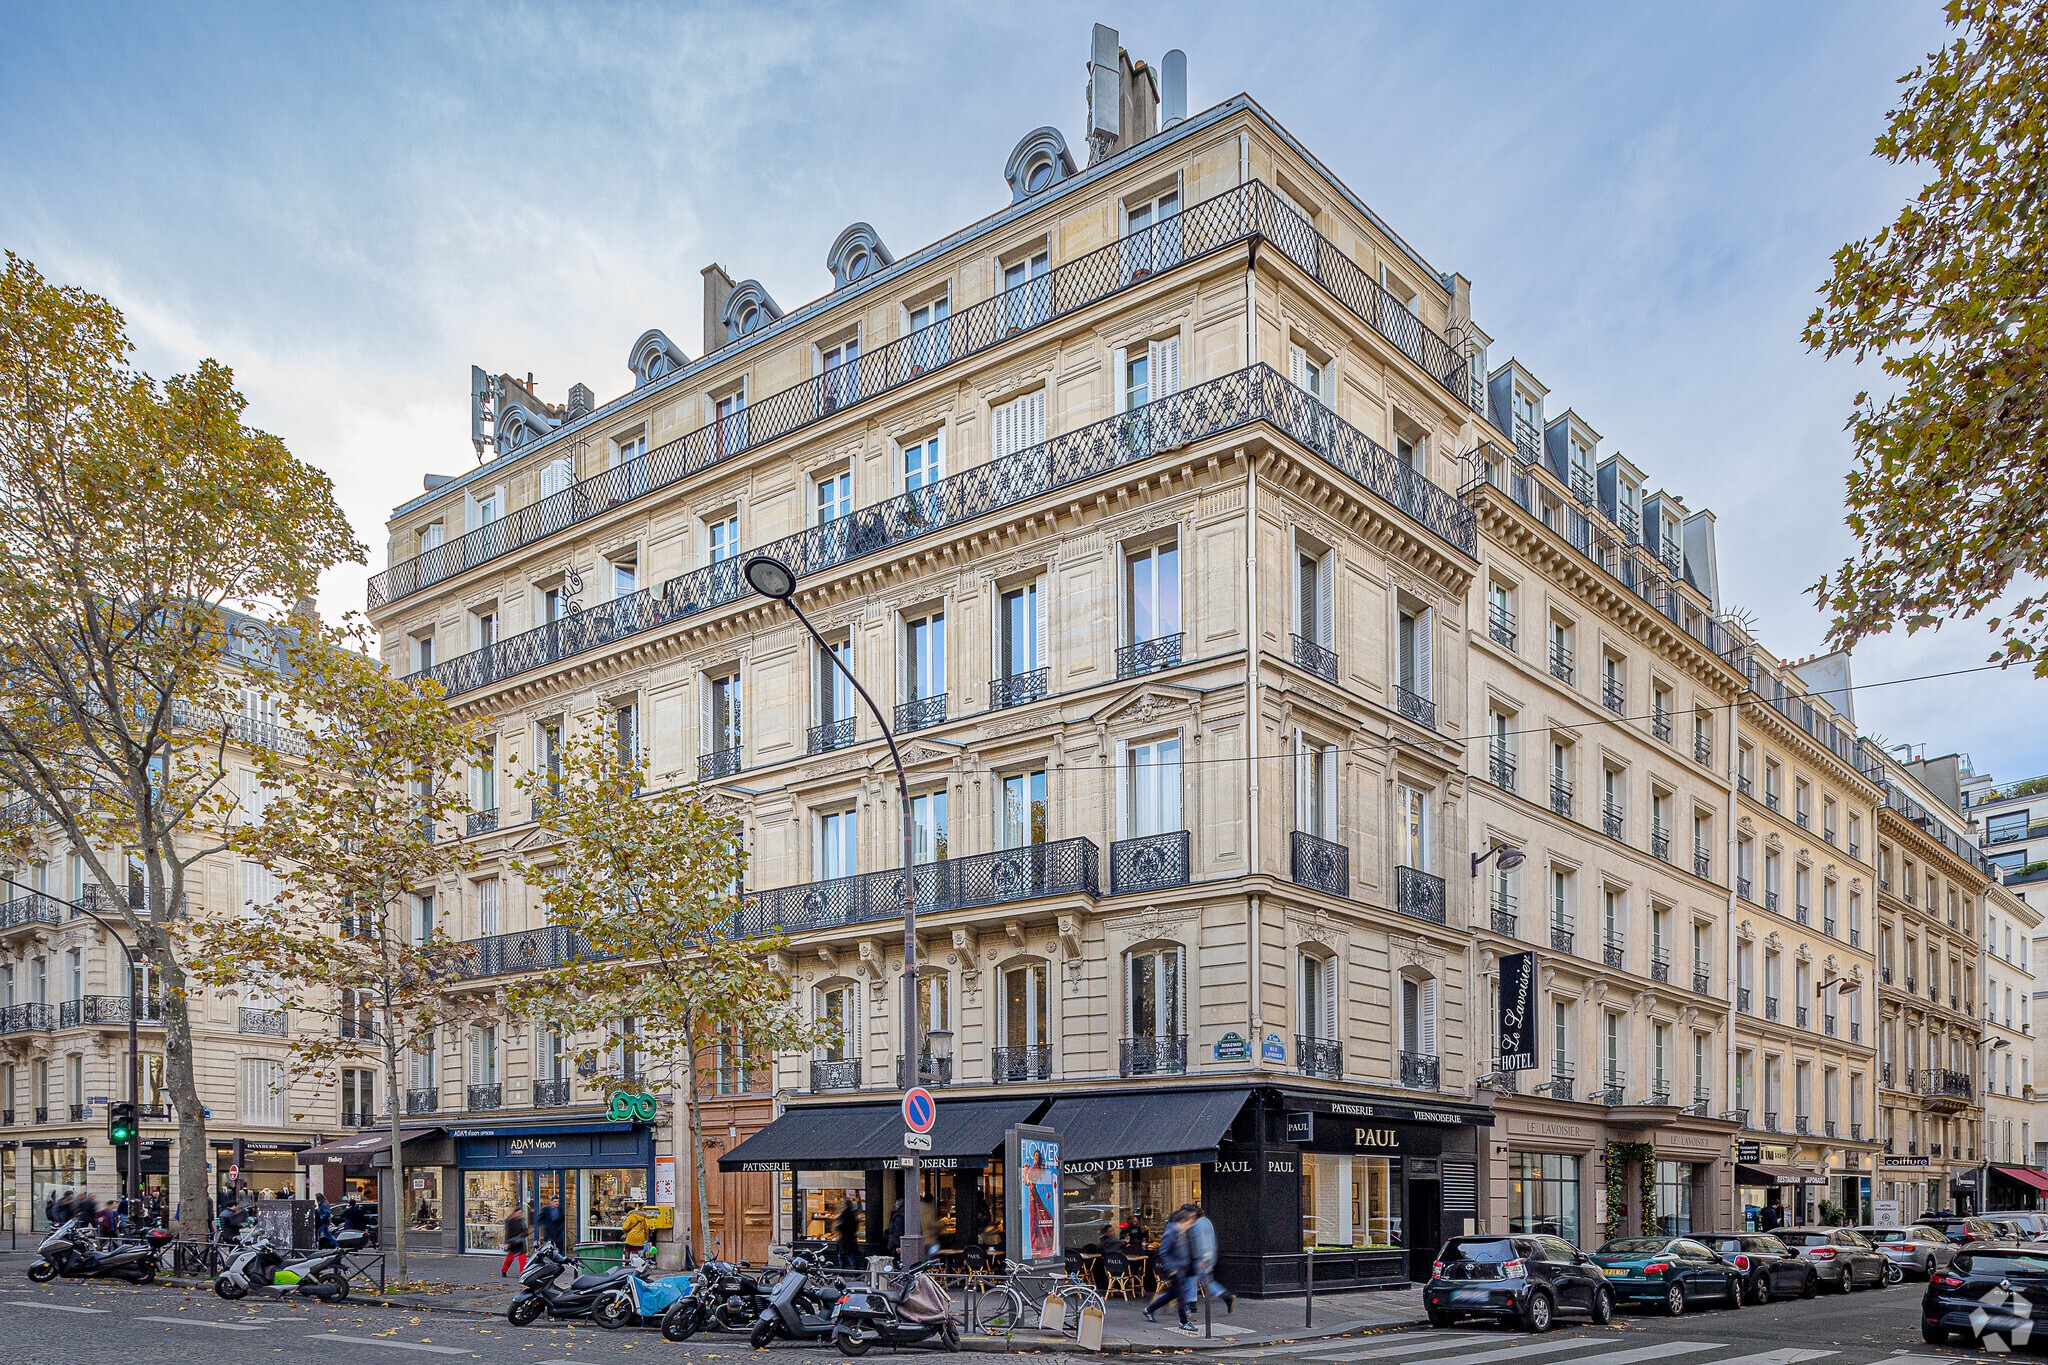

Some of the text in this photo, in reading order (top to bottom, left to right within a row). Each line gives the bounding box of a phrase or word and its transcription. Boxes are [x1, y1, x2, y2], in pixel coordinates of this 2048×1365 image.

[1502, 954, 1531, 1051] Le Lavoisier
[1502, 1053, 1533, 1070] HOTEL
[1331, 1103, 1374, 1116] PATISSERIE
[1413, 1110, 1462, 1124] VIENNOISERIE
[1288, 1122, 1309, 1132] PAUL
[1526, 1122, 1580, 1137] LE LAVOISIER
[510, 1139, 534, 1149] ADAM
[1354, 1128, 1400, 1147] PAUL
[1670, 1135, 1710, 1147] LE LAVOISIER
[1021, 1141, 1059, 1162] FLOWER
[742, 1162, 790, 1172] PATISSERIE
[1064, 1161, 1102, 1174] SALON
[1107, 1159, 1124, 1170] DE
[1128, 1157, 1153, 1169] THE
[1214, 1162, 1252, 1173] PAUL
[1268, 1162, 1295, 1173] PAUL
[1885, 1156, 1928, 1166] coiffure
